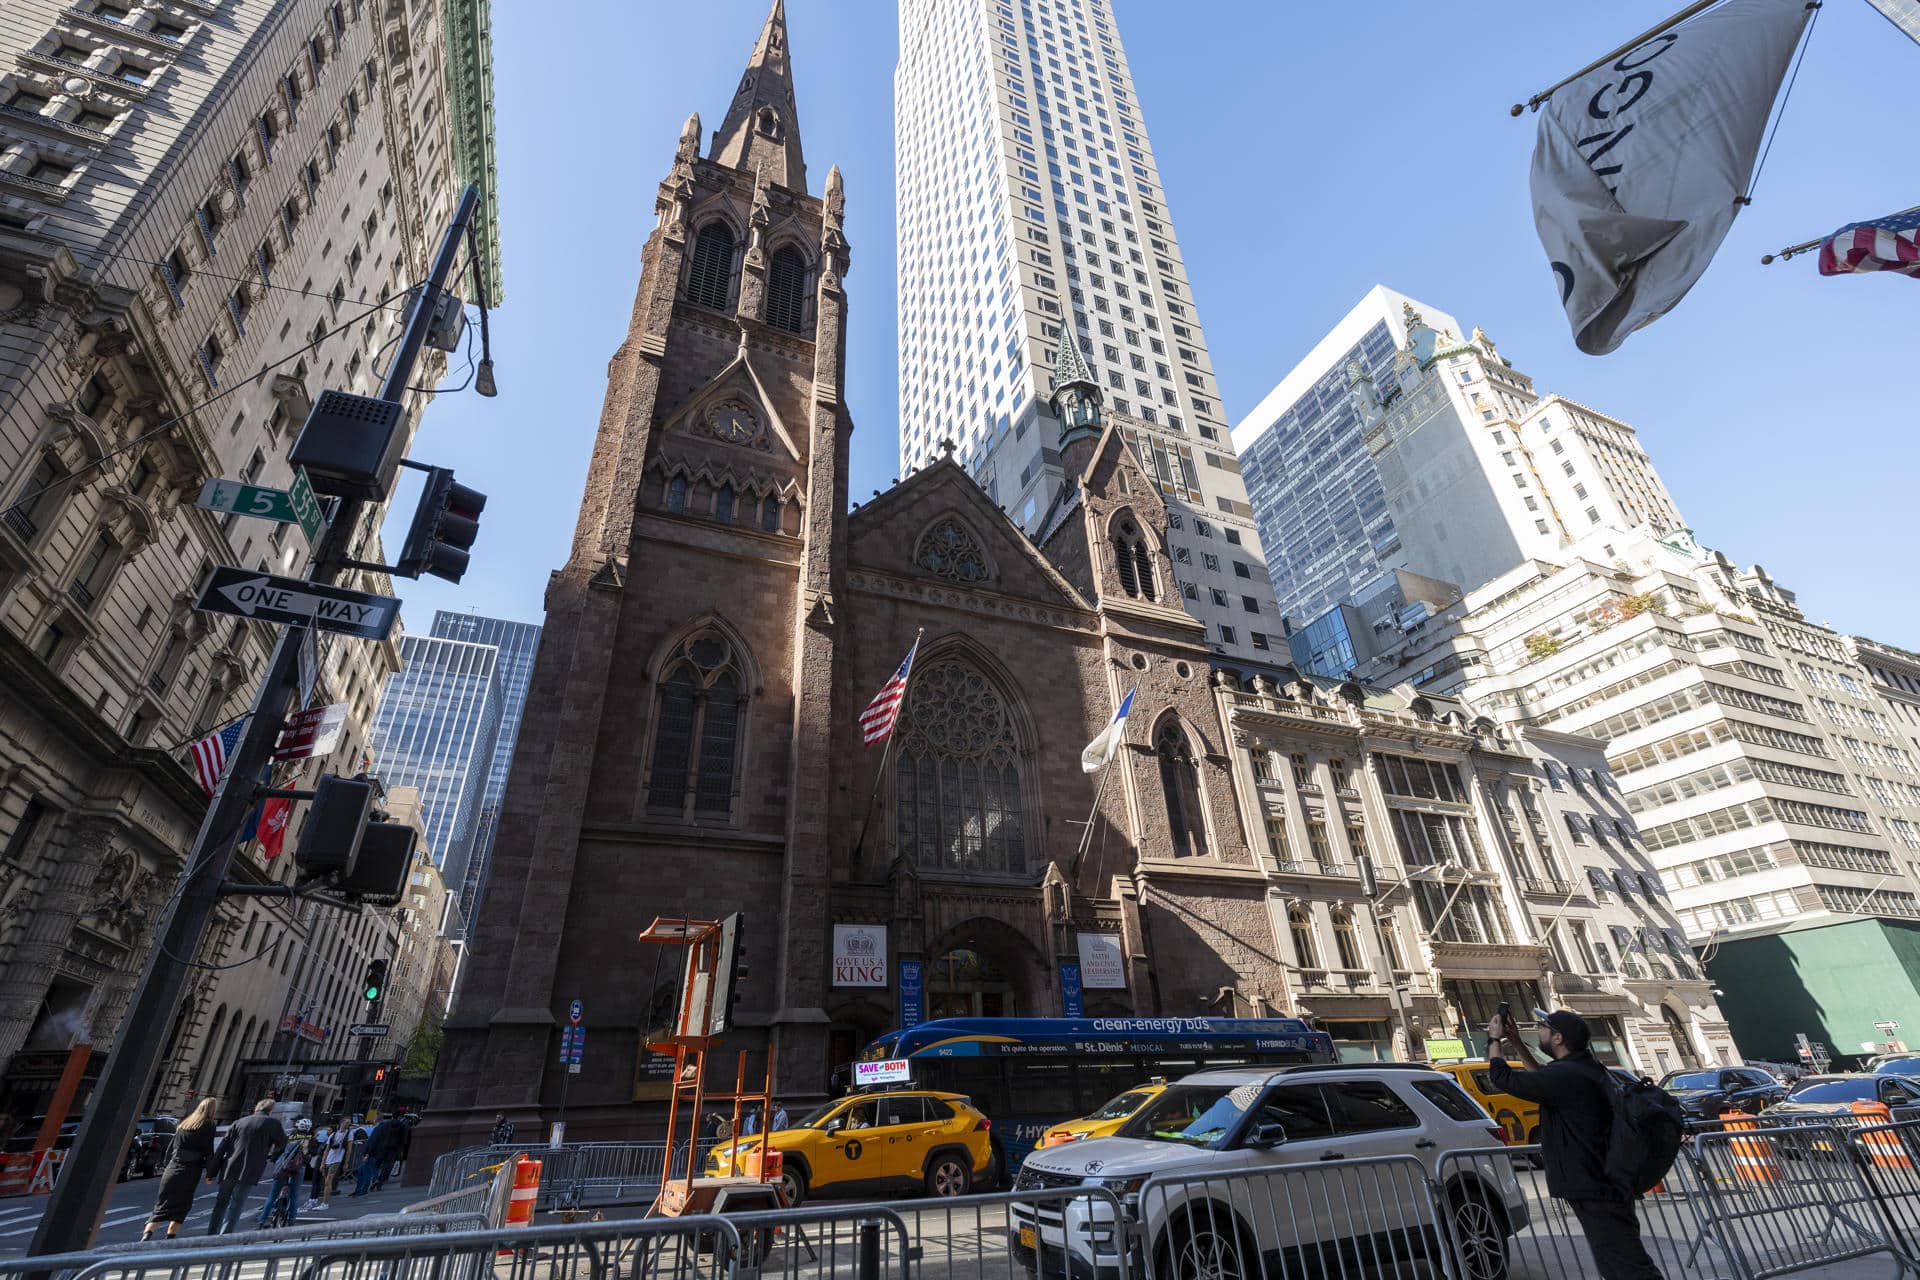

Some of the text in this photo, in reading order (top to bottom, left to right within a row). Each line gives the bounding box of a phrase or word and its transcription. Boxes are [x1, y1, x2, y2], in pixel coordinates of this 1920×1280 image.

[291, 475, 305, 501] E
[250, 491, 276, 514] 5
[296, 488, 311, 520] 55
[237, 585, 374, 623] ONE WAY
[836, 958, 885, 967] GIVE US A
[836, 966, 883, 982] KING
[1093, 1018, 1210, 1033] clean-energy bus
[1011, 1045, 1027, 1053] quite
[1084, 1042, 1097, 1052] St.
[1130, 1044, 1165, 1052] MEDICAL
[858, 1063, 879, 1073] SAVE
[884, 1061, 906, 1071] BOTH
[848, 1143, 858, 1158] T
